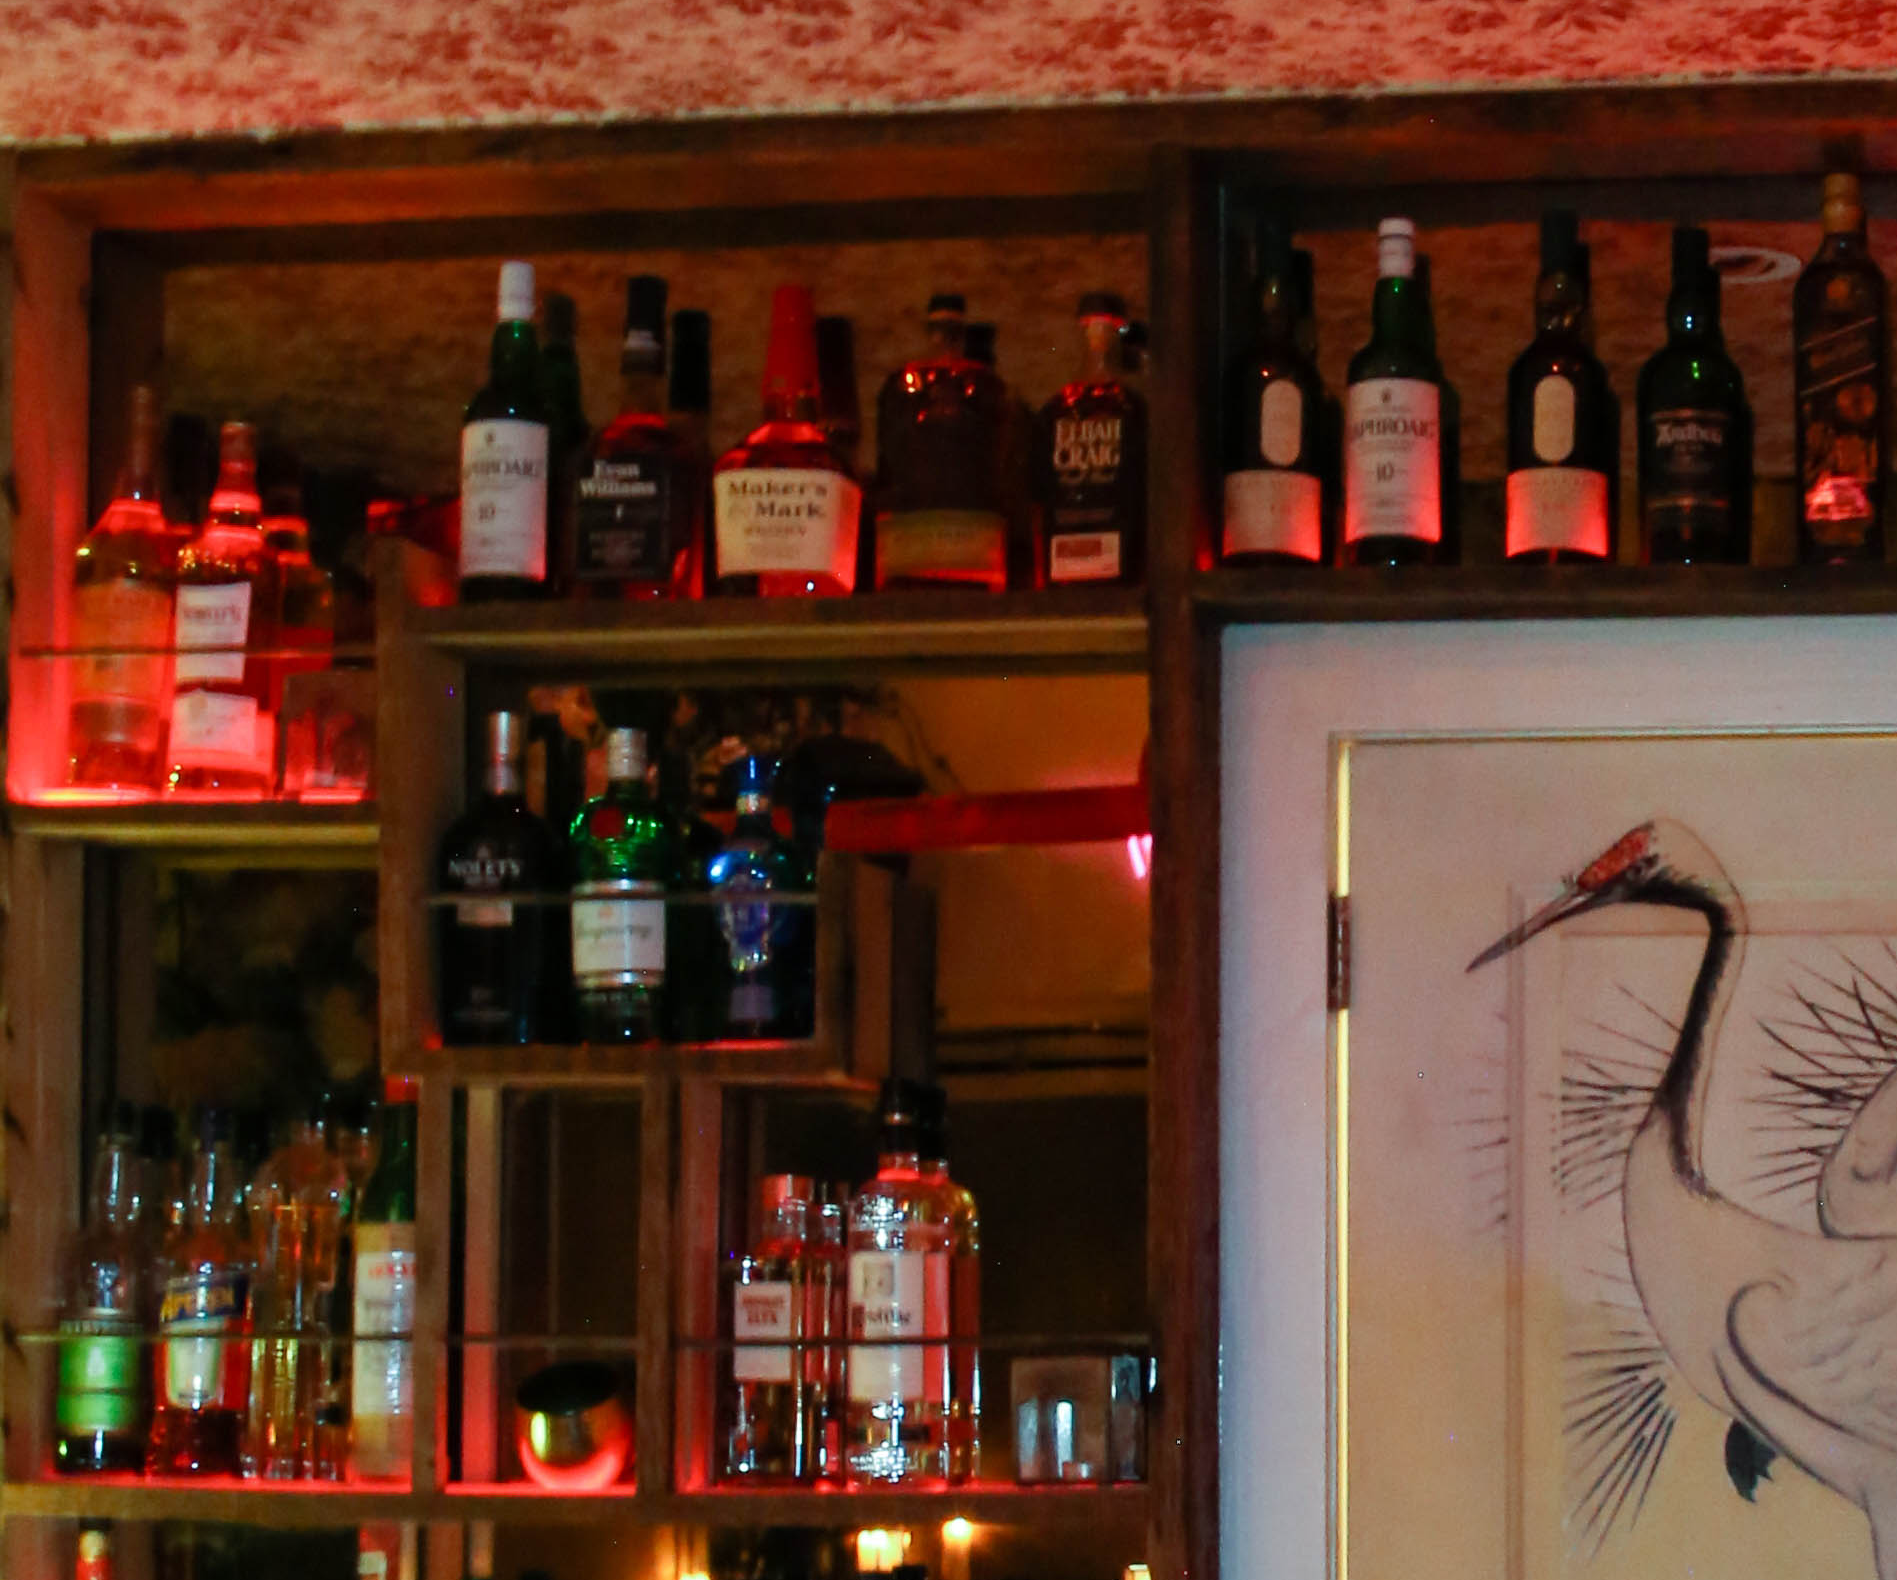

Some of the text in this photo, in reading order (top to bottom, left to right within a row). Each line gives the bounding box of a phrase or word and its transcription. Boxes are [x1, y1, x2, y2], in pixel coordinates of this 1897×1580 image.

[1055, 418, 1122, 444] ELIJAH
[1052, 444, 1122, 469] CRAIG
[593, 460, 641, 478] Evan
[1377, 462, 1395, 482] 10
[580, 479, 657, 498] Williams
[728, 479, 828, 497] Maker's
[478, 503, 497, 522] 10
